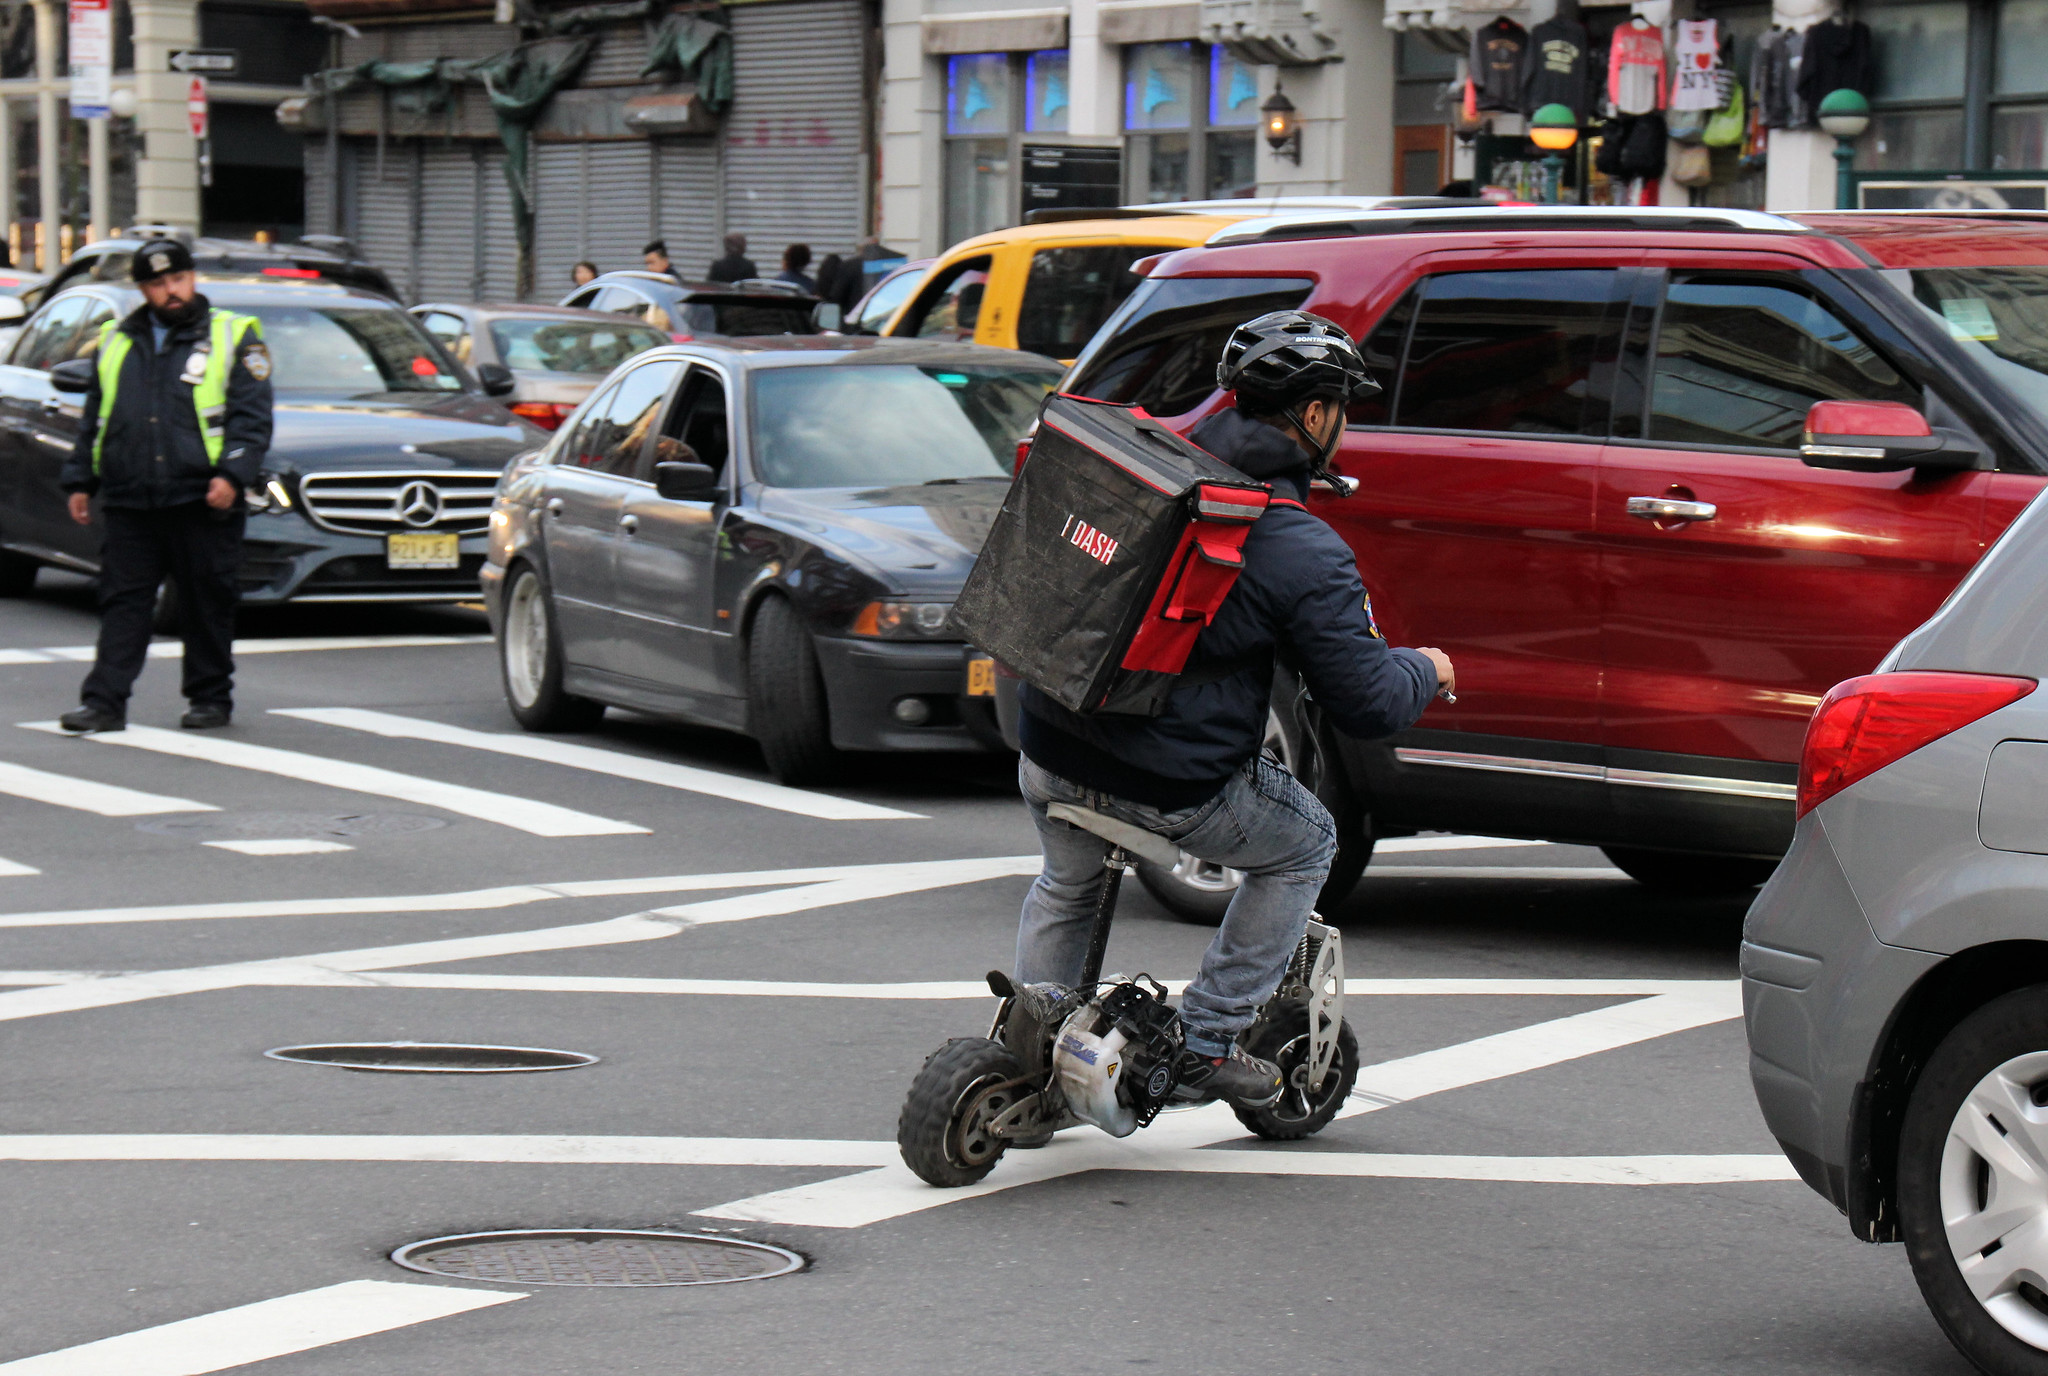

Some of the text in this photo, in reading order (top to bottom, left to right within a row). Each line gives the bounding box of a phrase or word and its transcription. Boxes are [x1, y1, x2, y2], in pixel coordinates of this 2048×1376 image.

[1682, 53, 1692, 69] I
[1681, 72, 1713, 88] NY
[1295, 336, 1341, 346] BONTRAGER
[1060, 514, 1119, 566] I DASH
